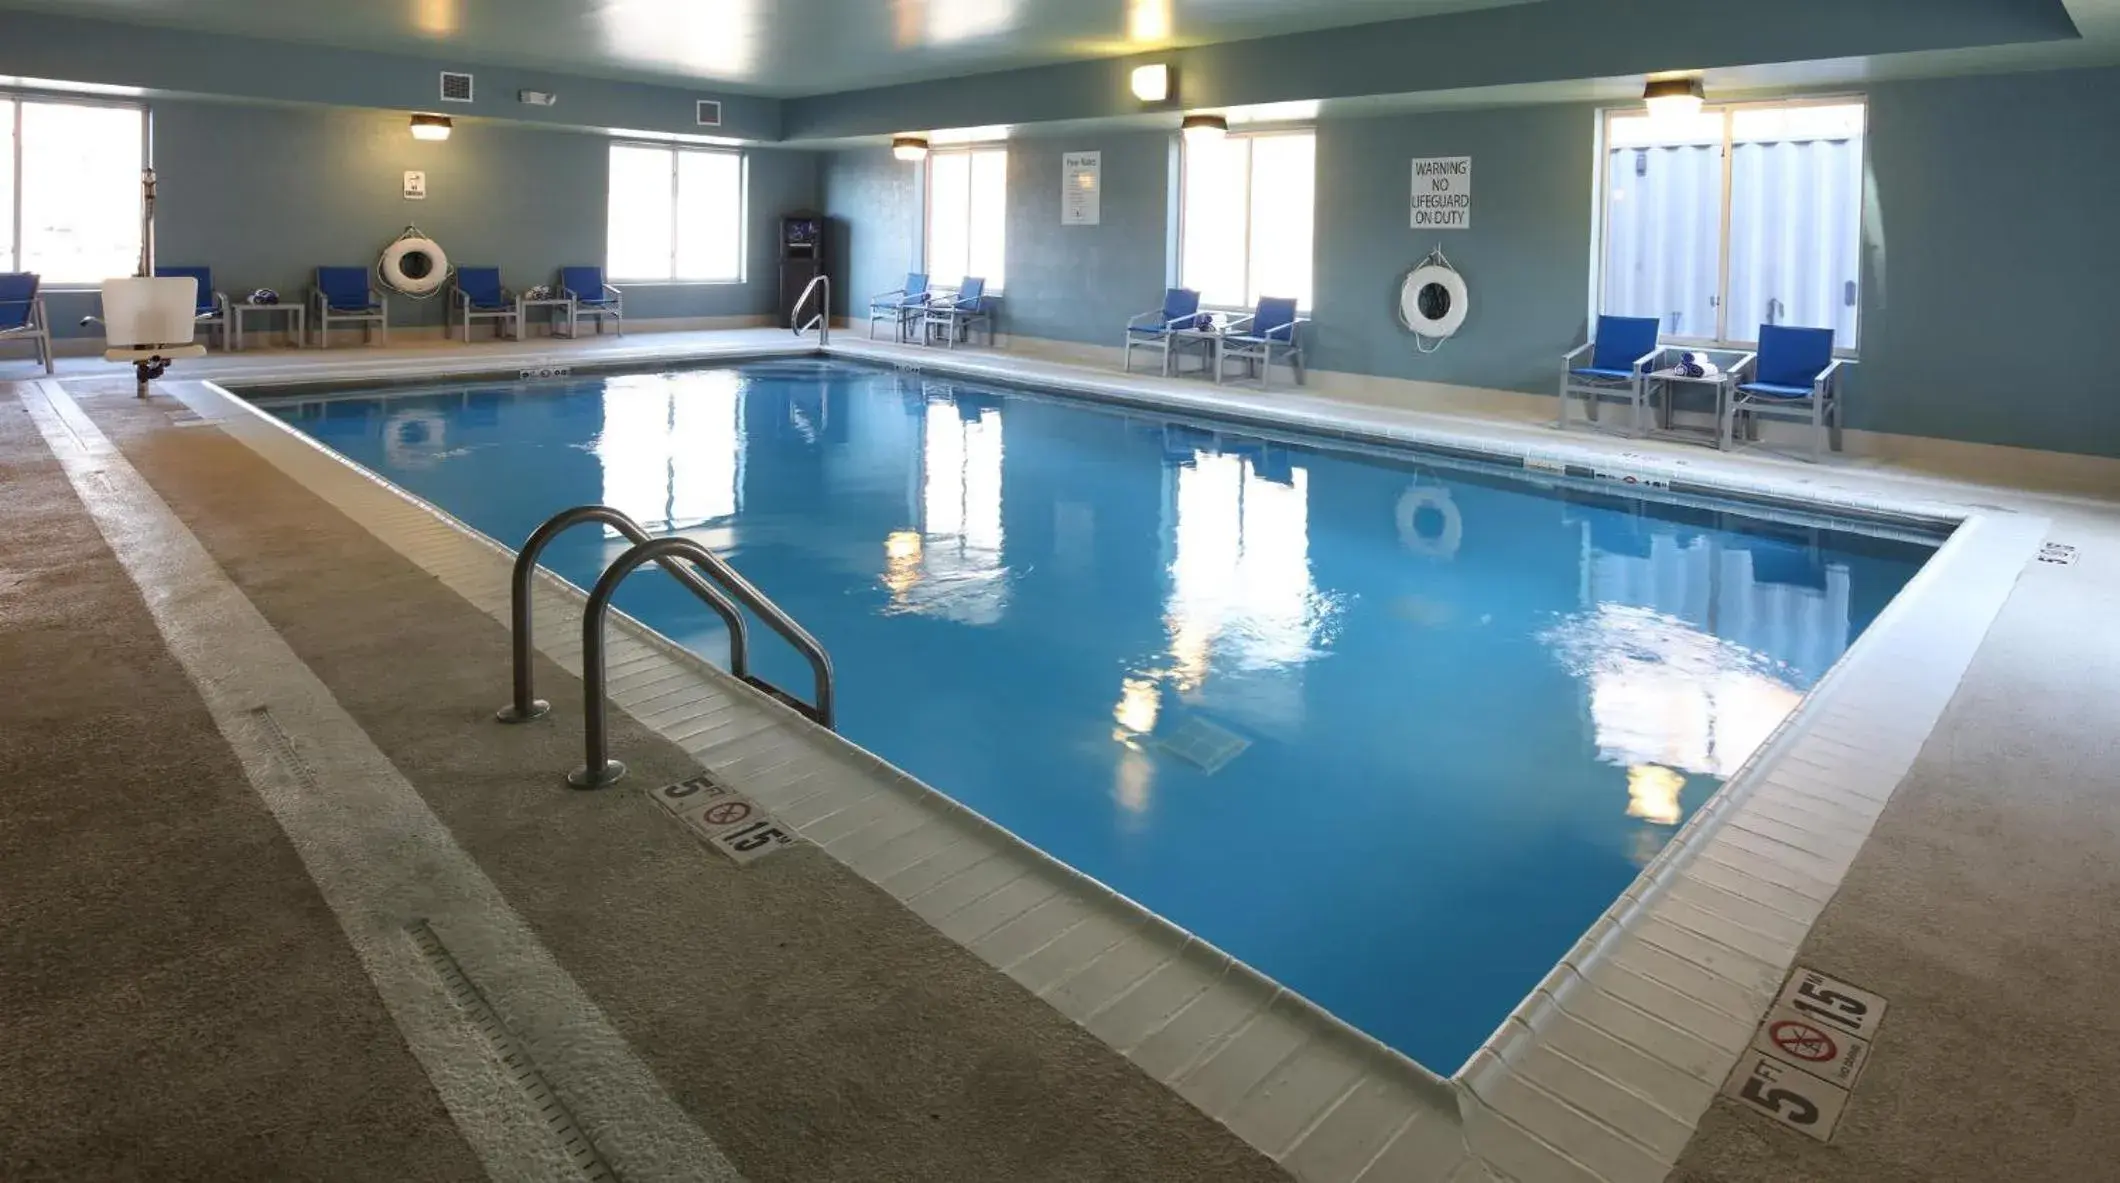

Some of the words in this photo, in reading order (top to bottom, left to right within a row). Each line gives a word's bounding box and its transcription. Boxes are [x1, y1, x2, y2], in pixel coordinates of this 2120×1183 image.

[1415, 160, 1467, 176] WARNING
[1432, 178, 1449, 191] NO
[1412, 194, 1469, 208] LIFEGUARD
[1415, 210, 1431, 224] ON
[1434, 210, 1464, 224] DUTY
[664, 777, 714, 798] 5
[1740, 1076, 1819, 1125] 5
